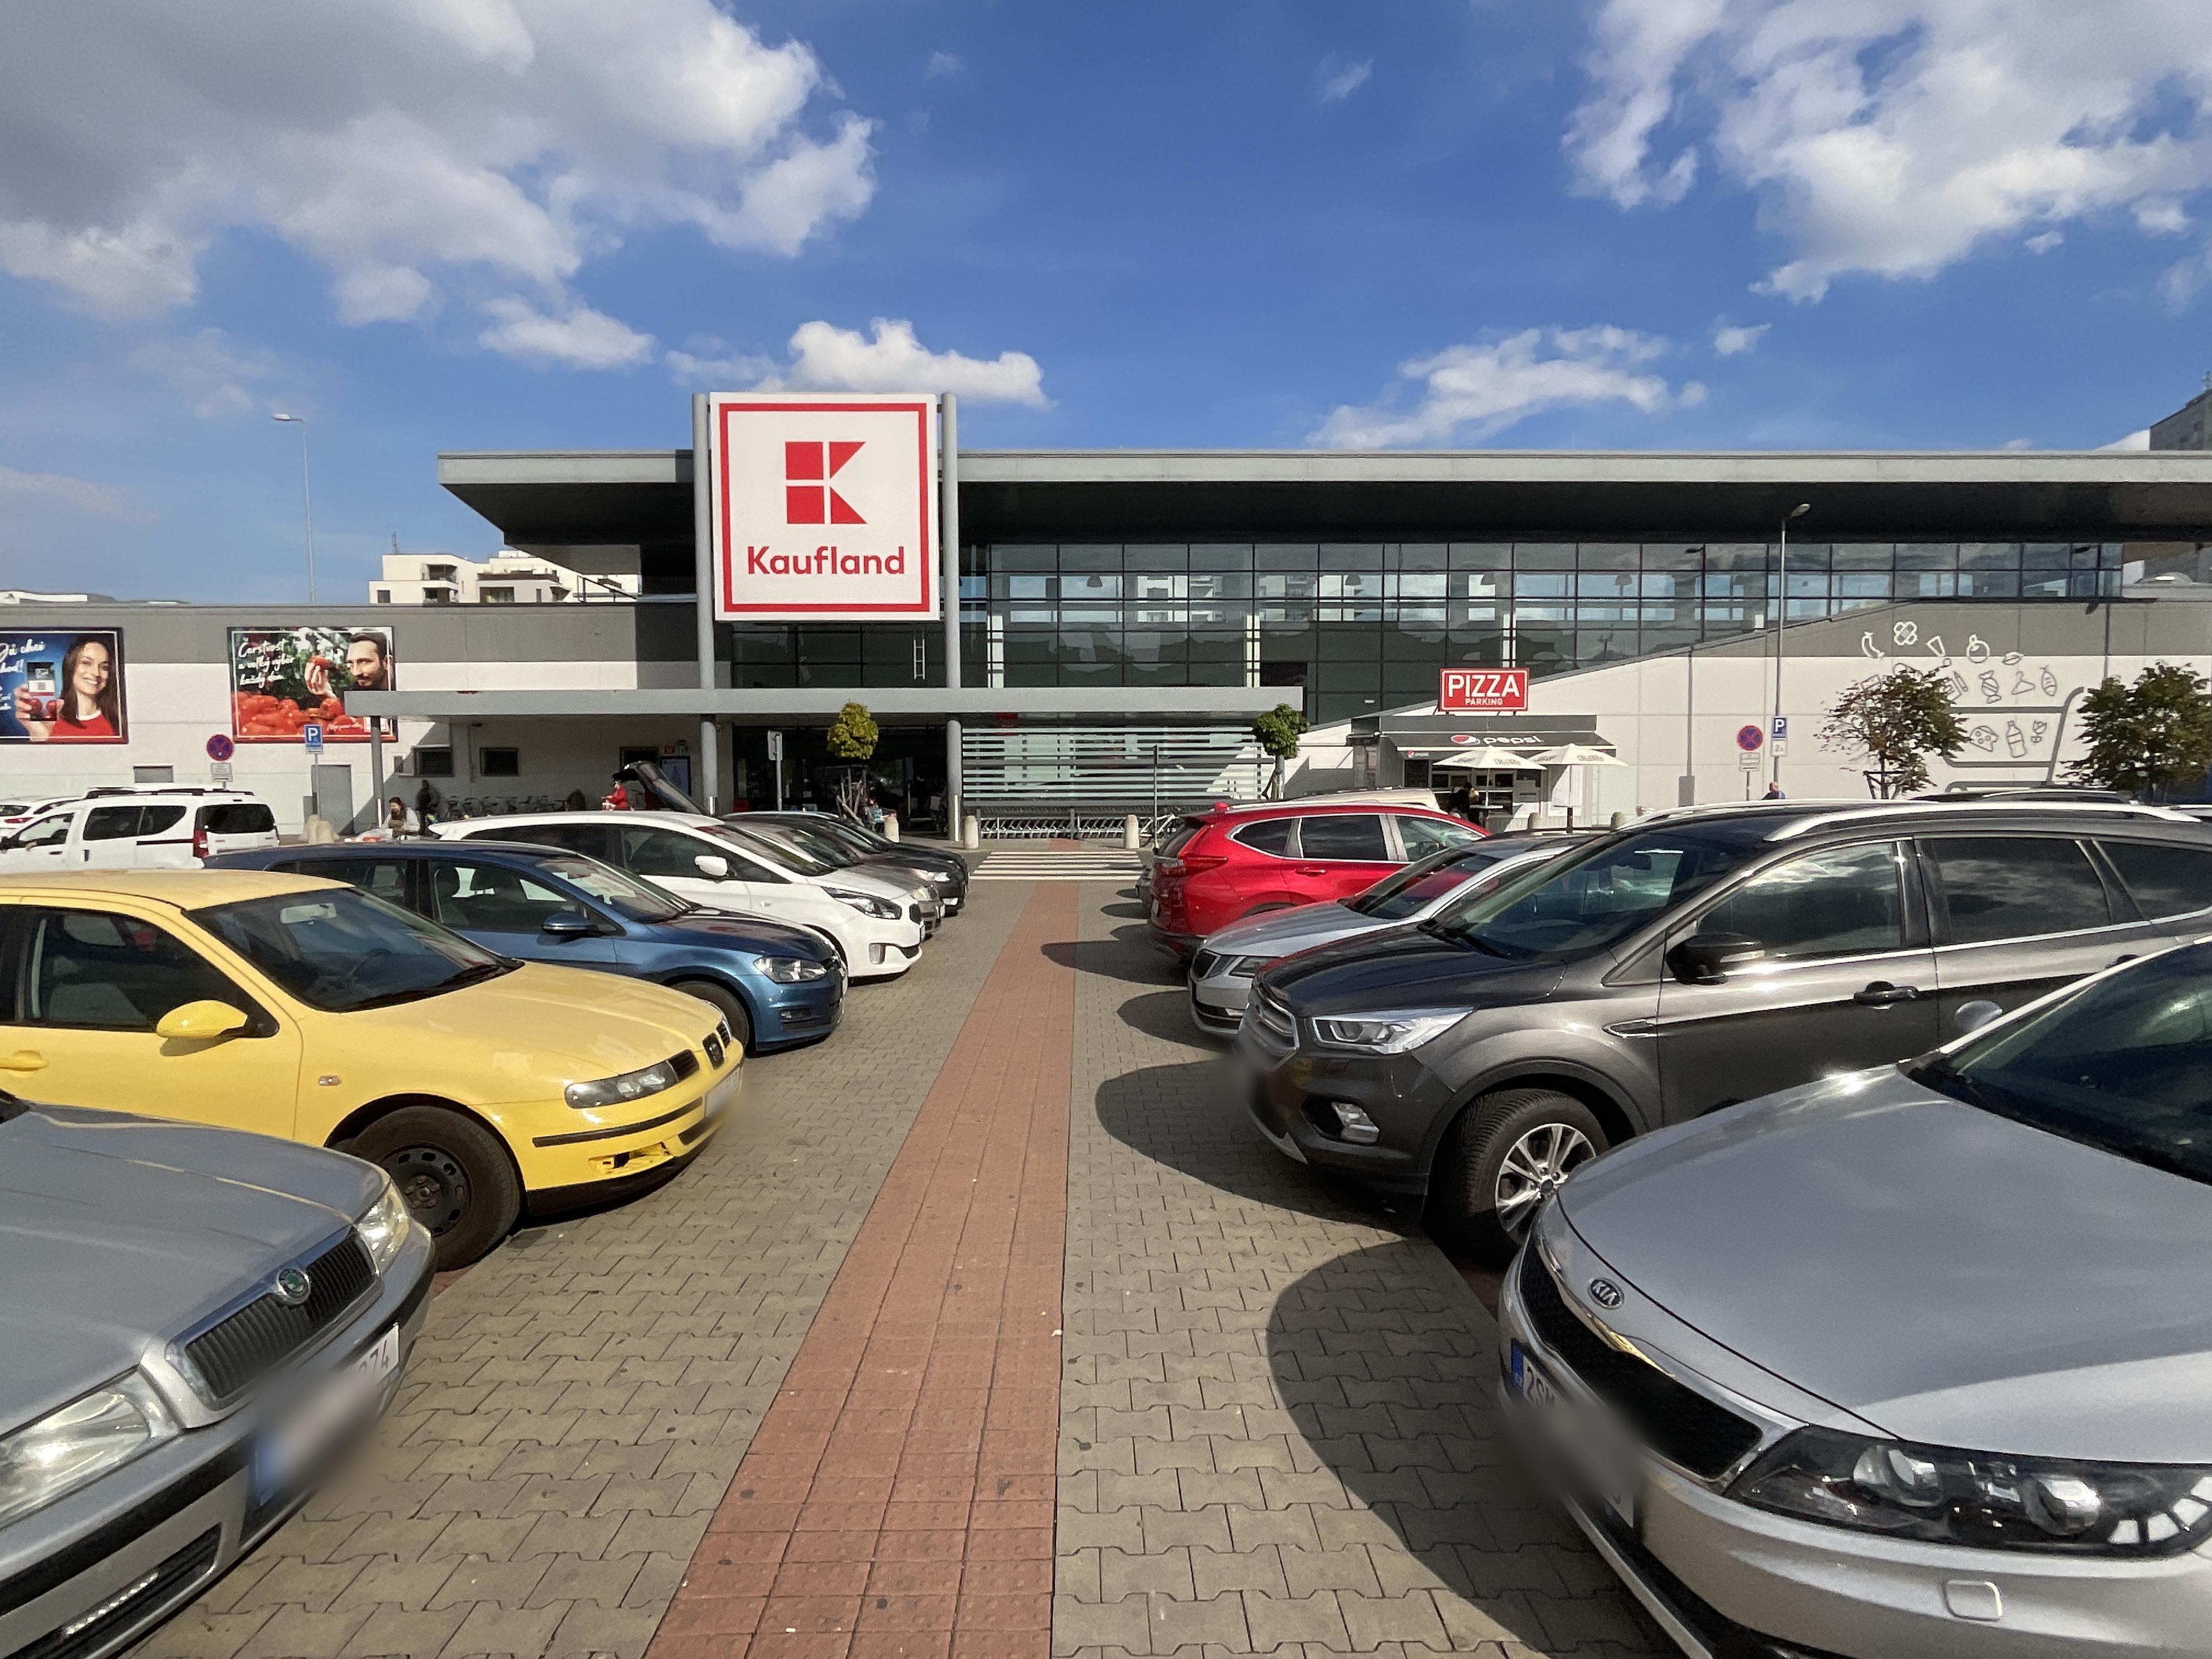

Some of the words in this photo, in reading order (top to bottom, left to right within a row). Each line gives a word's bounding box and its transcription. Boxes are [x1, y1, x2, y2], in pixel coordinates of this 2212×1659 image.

[746, 545, 905, 575] Kaufland
[1448, 675, 1520, 698] PIZZA
[1775, 719, 1785, 732] P
[308, 728, 318, 742] P
[1483, 735, 1541, 744] pepsi
[1592, 1281, 1618, 1306] KIA
